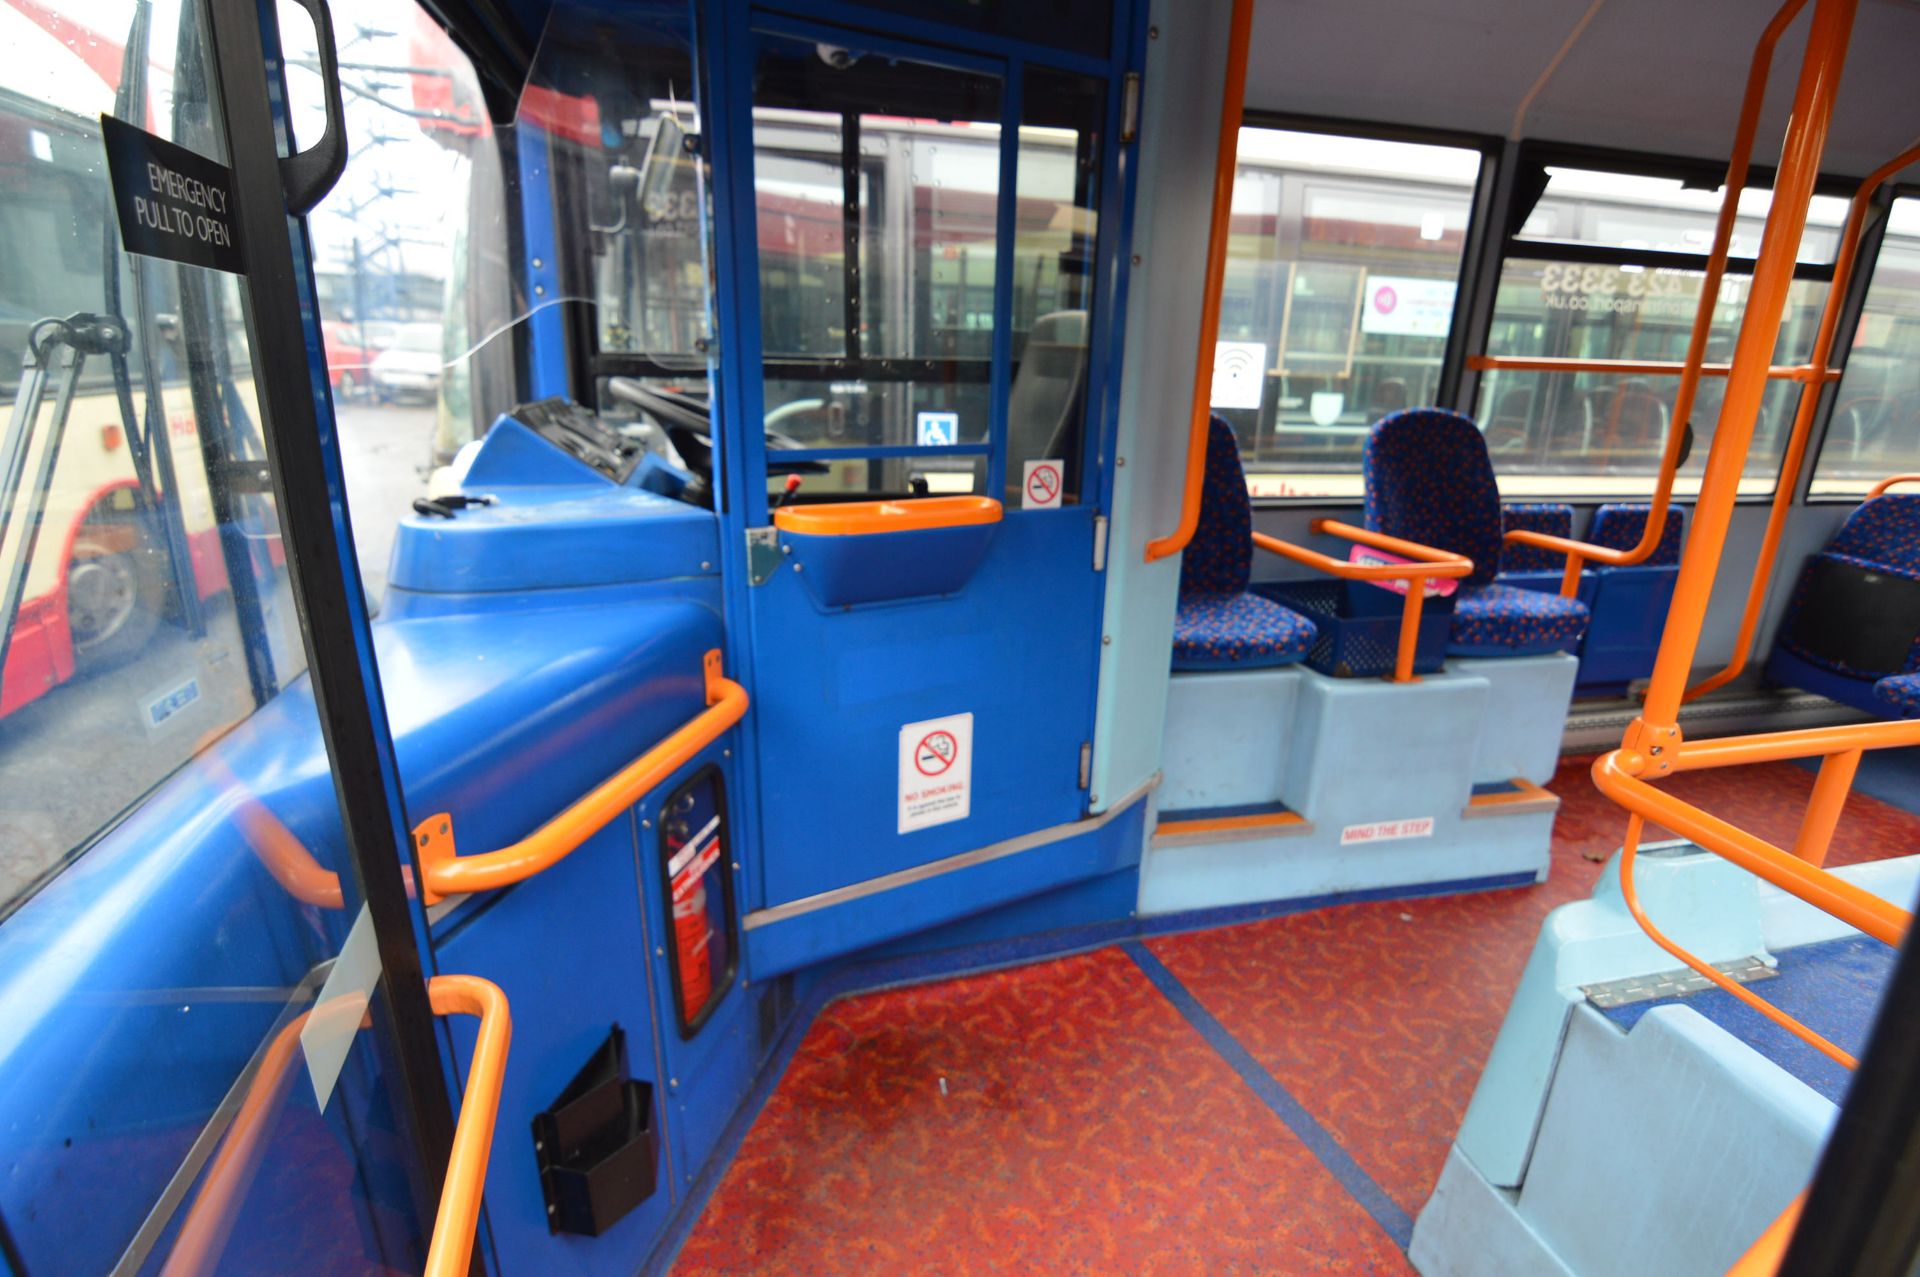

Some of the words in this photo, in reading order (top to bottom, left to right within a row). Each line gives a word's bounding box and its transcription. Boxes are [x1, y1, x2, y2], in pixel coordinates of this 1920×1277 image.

[147, 162, 226, 214] EMERGENCY
[134, 196, 175, 233] PULL
[173, 208, 194, 238] TO
[196, 216, 231, 247] OPEN
[904, 791, 919, 802] NO
[921, 781, 964, 799] SMOKING
[1343, 825, 1375, 841] MIND
[1377, 823, 1398, 838] THE
[1401, 820, 1431, 836] STEP
